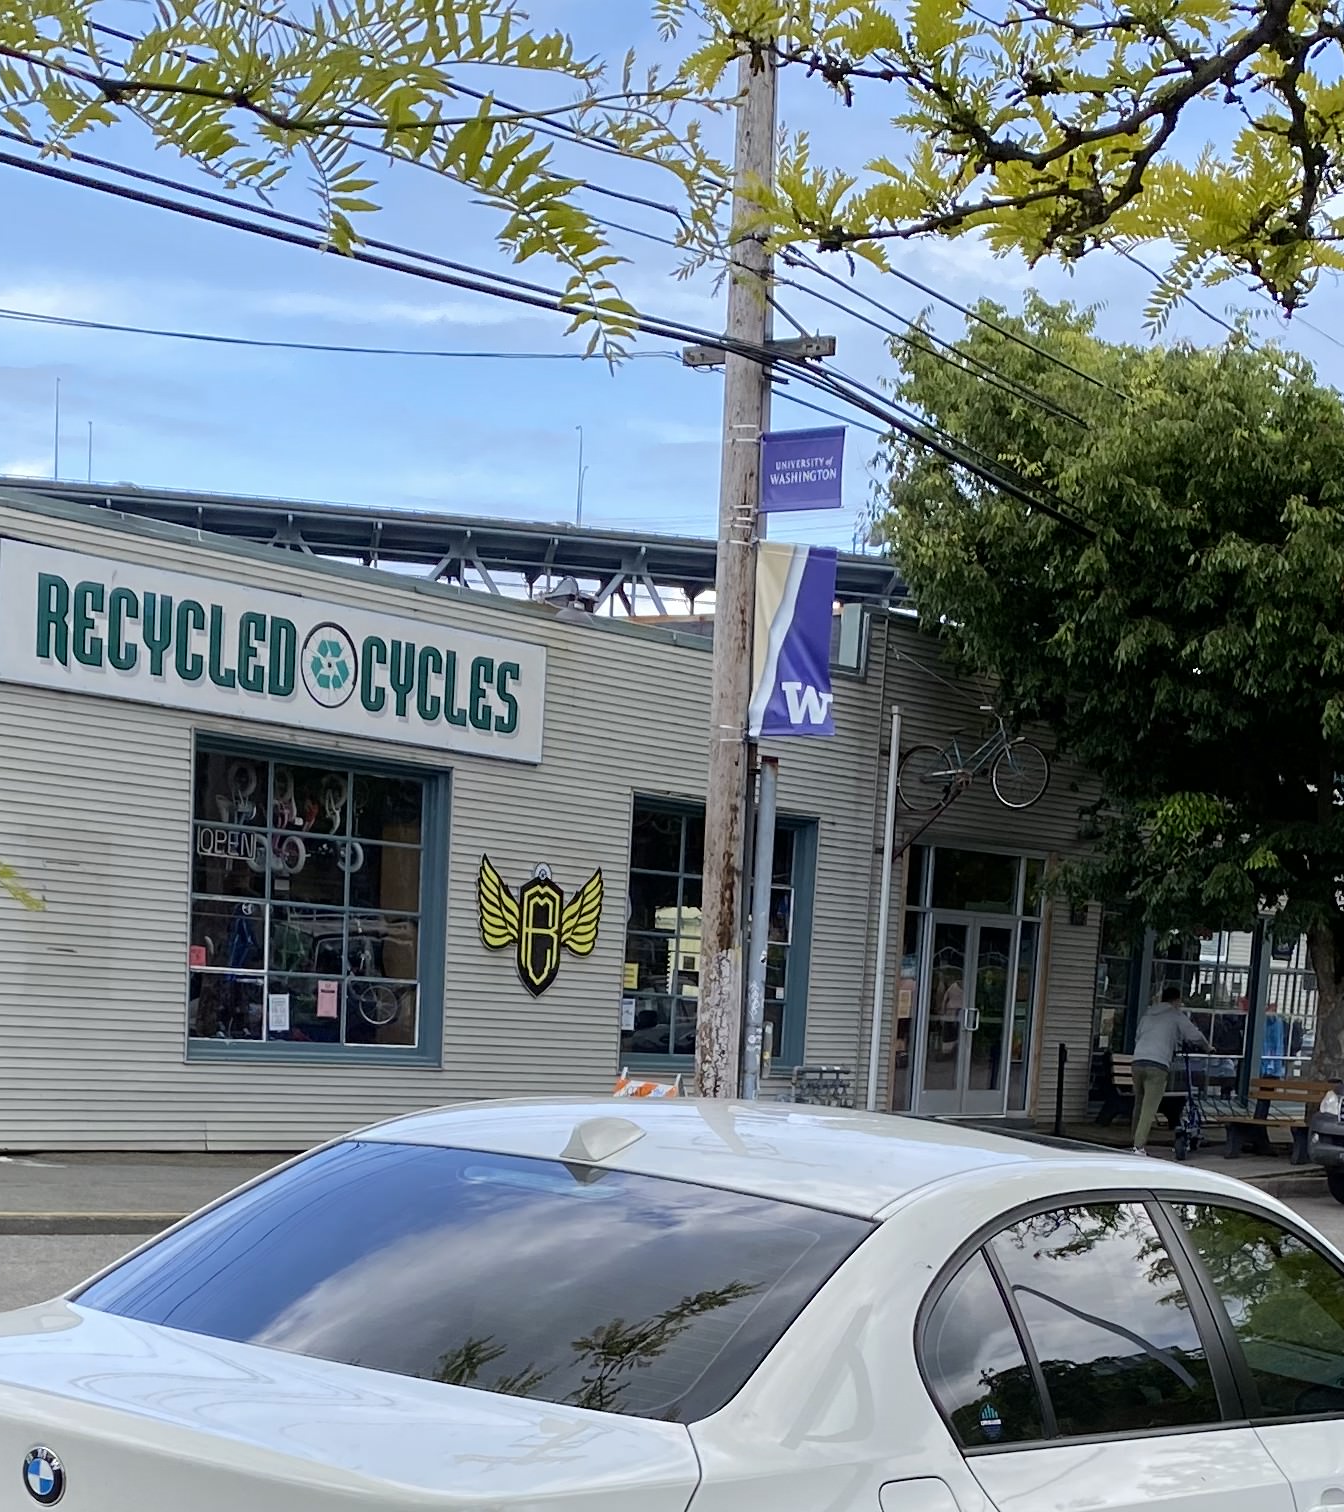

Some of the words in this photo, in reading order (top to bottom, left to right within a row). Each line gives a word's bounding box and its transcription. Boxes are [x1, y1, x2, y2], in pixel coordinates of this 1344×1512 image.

[769, 467, 837, 485] WASHINGTON
[775, 457, 825, 471] UNIVERSITY
[824, 455, 834, 467] of
[36, 571, 297, 697] RECYCLED
[360, 635, 520, 734] CYCLES
[781, 681, 834, 725] W
[200, 827, 256, 858] OPEN
